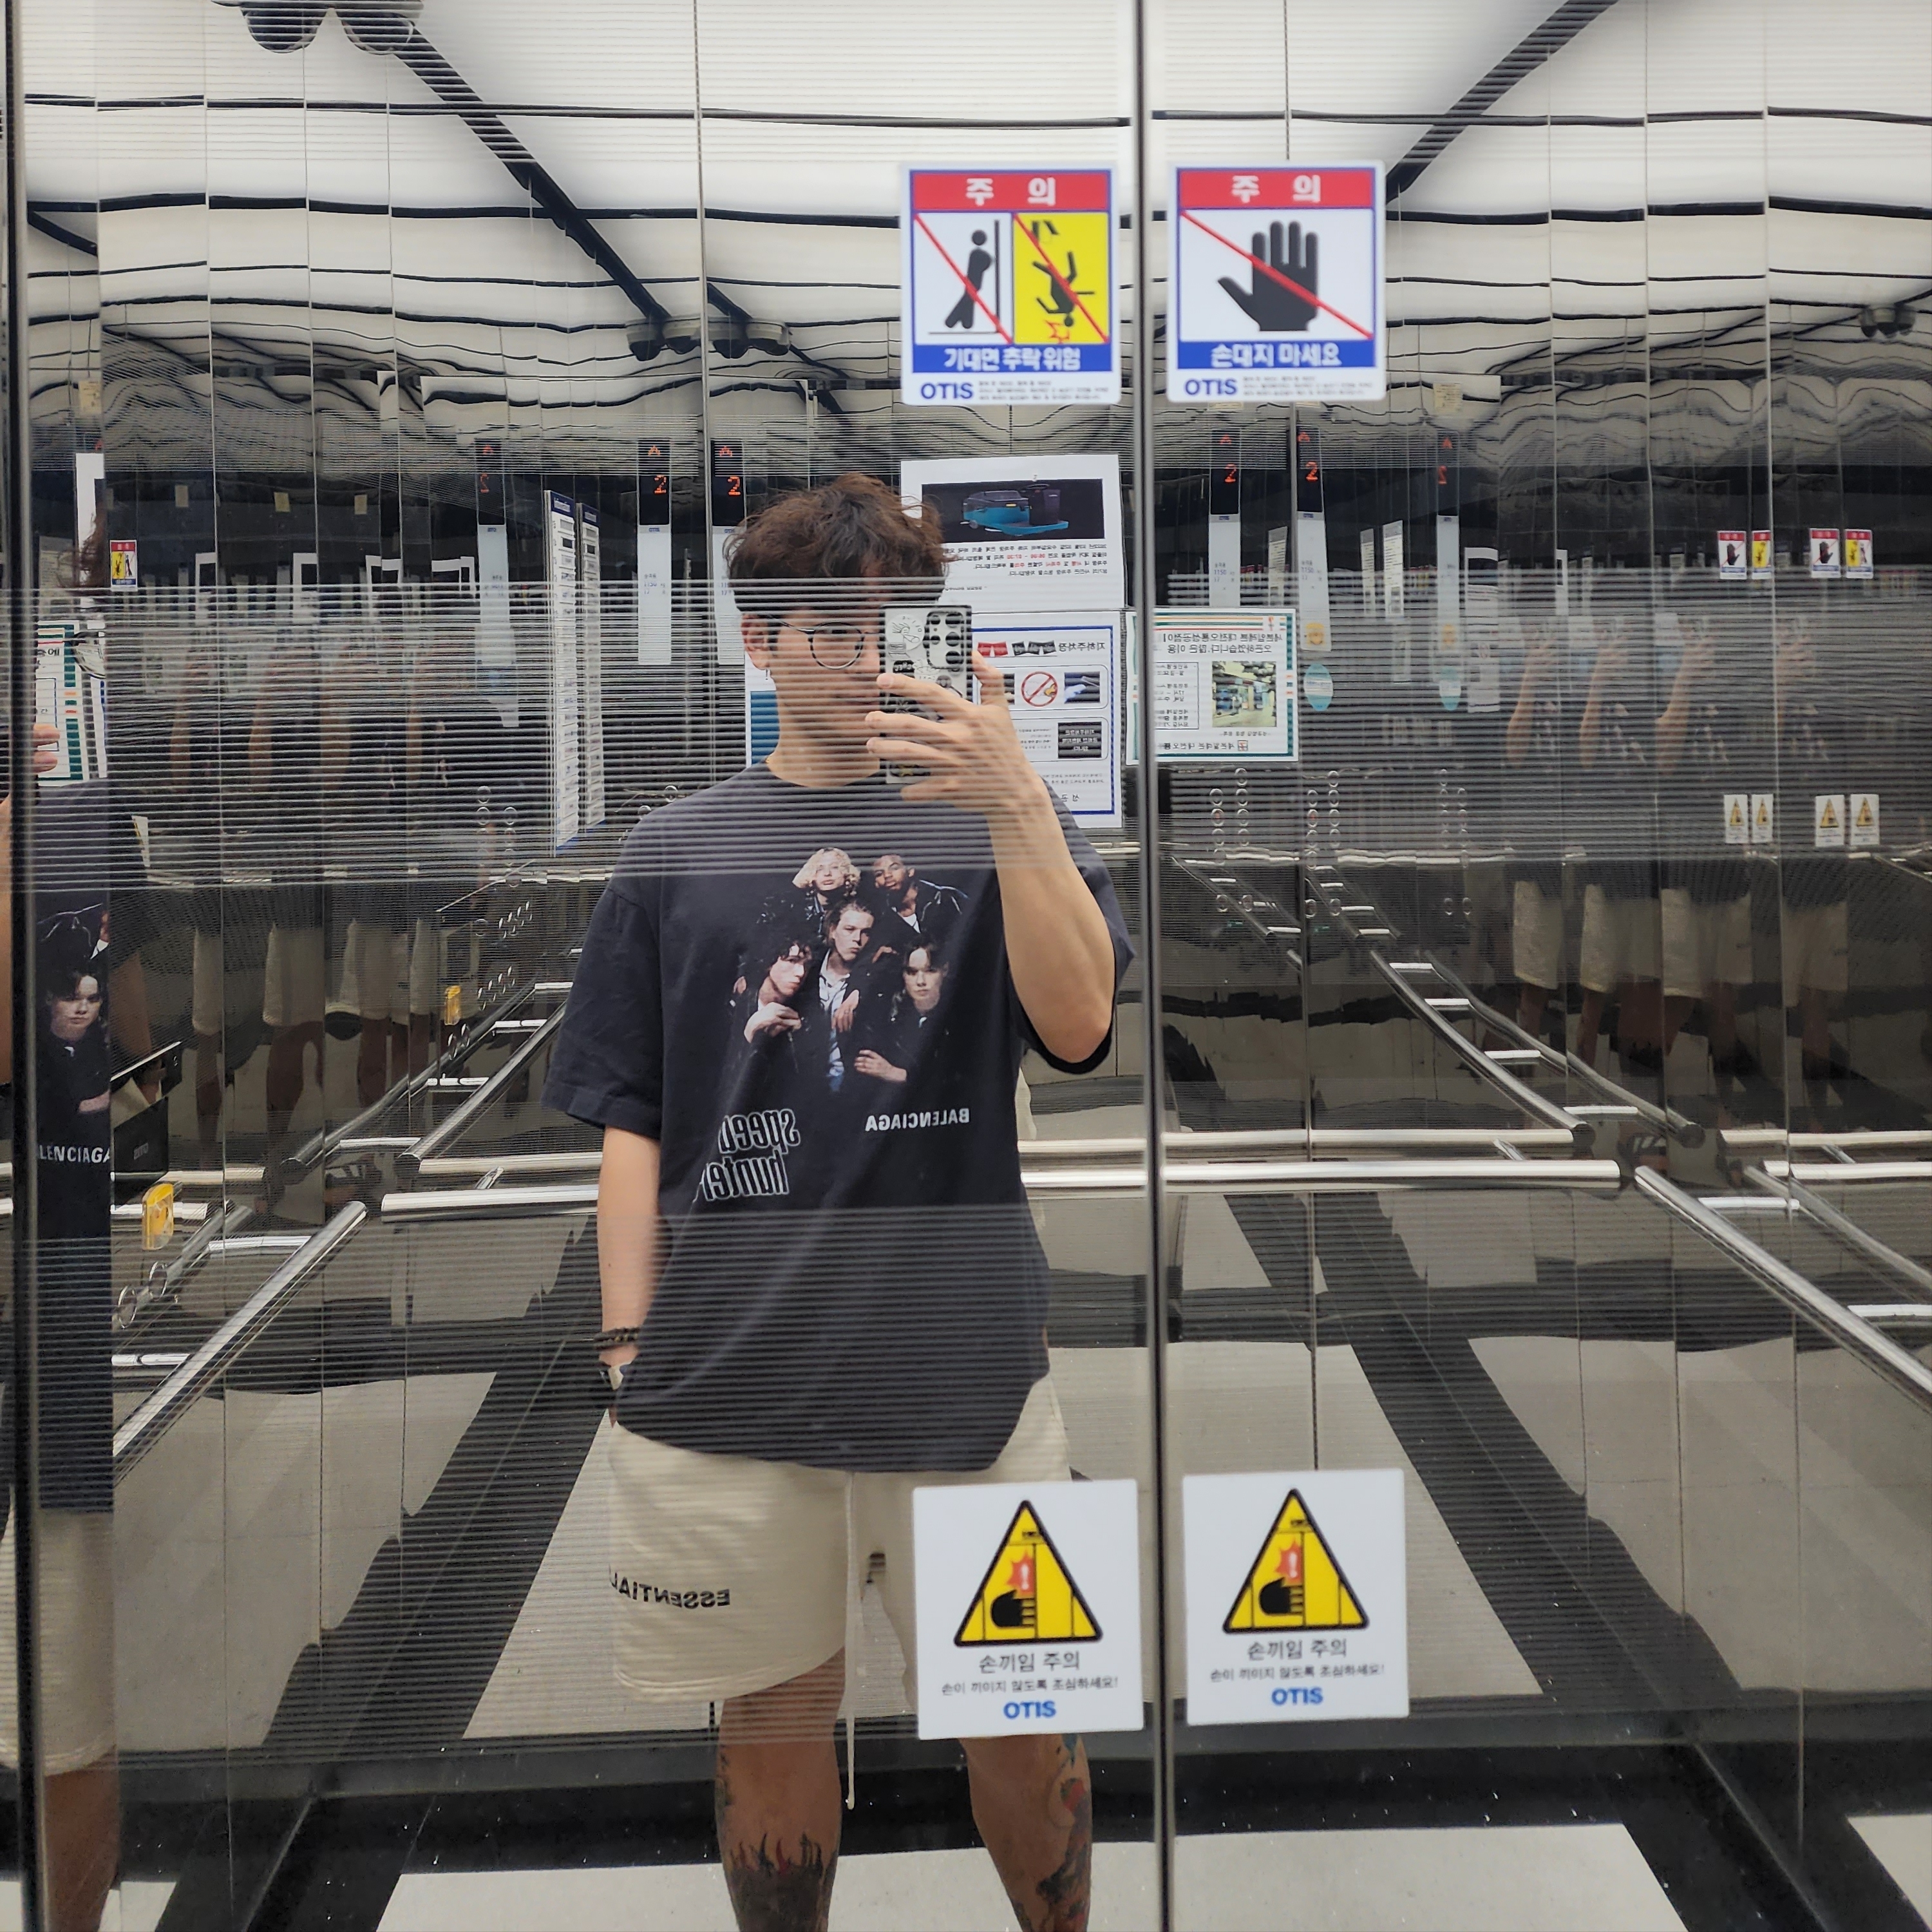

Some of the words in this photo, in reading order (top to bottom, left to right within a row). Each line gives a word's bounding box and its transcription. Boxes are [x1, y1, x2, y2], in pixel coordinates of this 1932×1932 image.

[966, 178, 994, 206] 주
[1028, 178, 1056, 205] 의
[1231, 175, 1260, 204] 주
[1293, 175, 1321, 202] 의
[944, 349, 1000, 371] 기대면
[1003, 348, 1040, 371] 추락
[1043, 347, 1081, 371] 위험
[1211, 345, 1274, 368] 손대지
[1278, 343, 1341, 367] 마세요
[920, 383, 974, 401] OTIS
[1184, 378, 1238, 397] OTIS
[1224, 463, 1236, 483] 2
[1305, 460, 1318, 482] 2
[654, 474, 667, 494] 2
[727, 476, 741, 495] 2
[1247, 1641, 1303, 1661] 손끼임
[1311, 1638, 1348, 1659] 주의
[979, 1653, 1034, 1672] 손끼임
[1043, 1651, 1080, 1671] 주의
[1210, 1669, 1236, 1681] 손이
[1240, 1667, 1275, 1680] 끼이지
[1320, 1662, 1385, 1677] 조심하세요!
[941, 1683, 967, 1694] 손이
[972, 1680, 1008, 1694] 끼이지
[1012, 1680, 1048, 1692] 않도록
[1052, 1676, 1119, 1690] 조심하세요!
[1271, 1687, 1323, 1706] OTIS
[1003, 1700, 1057, 1720] OTIS
